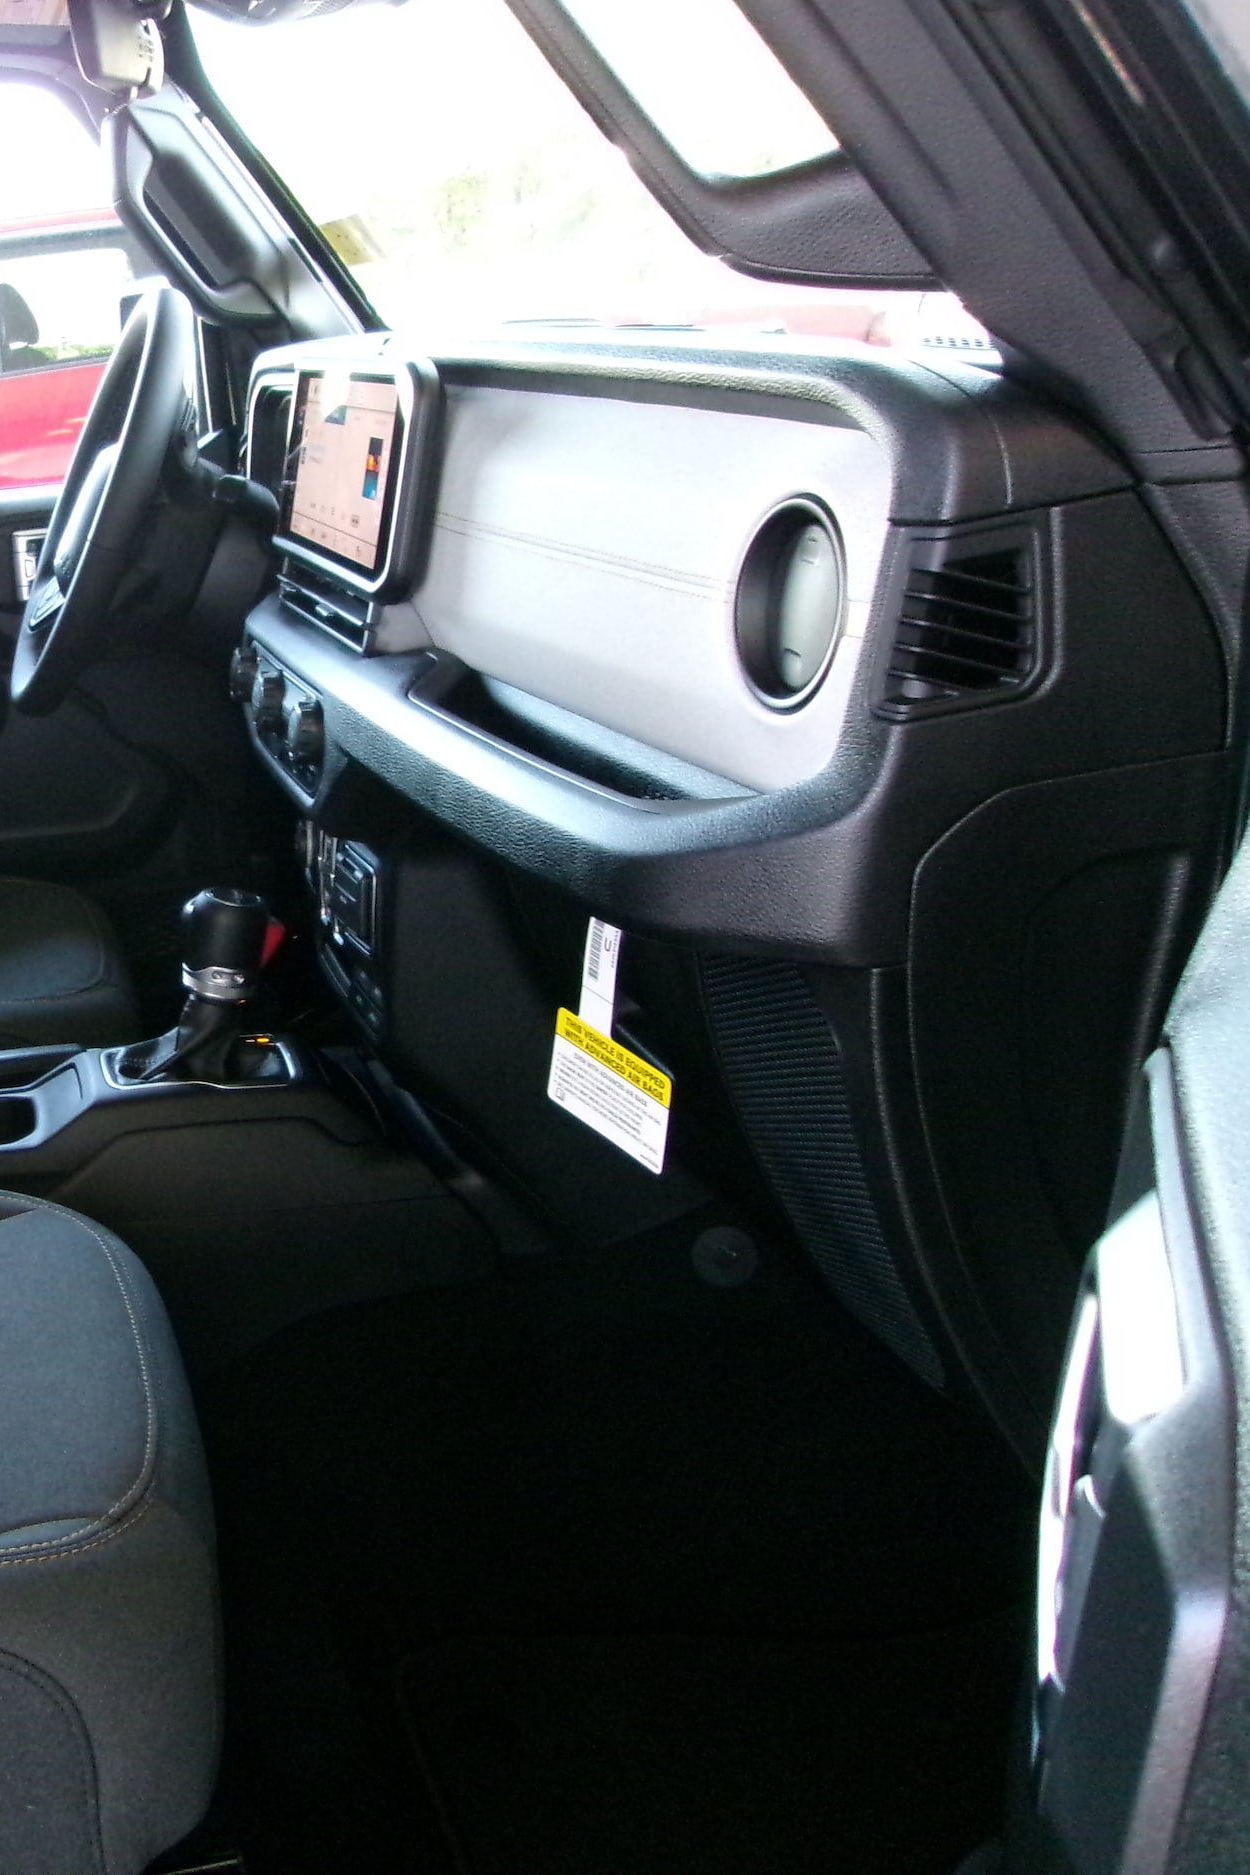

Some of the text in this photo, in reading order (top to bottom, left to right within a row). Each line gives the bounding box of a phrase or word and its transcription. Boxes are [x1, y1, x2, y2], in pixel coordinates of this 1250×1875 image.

[564, 1028, 664, 1101] WITH ADVANCED AIR BAGS
[565, 1016, 666, 1089] THIS VEHICLE IS EQUIPPED
